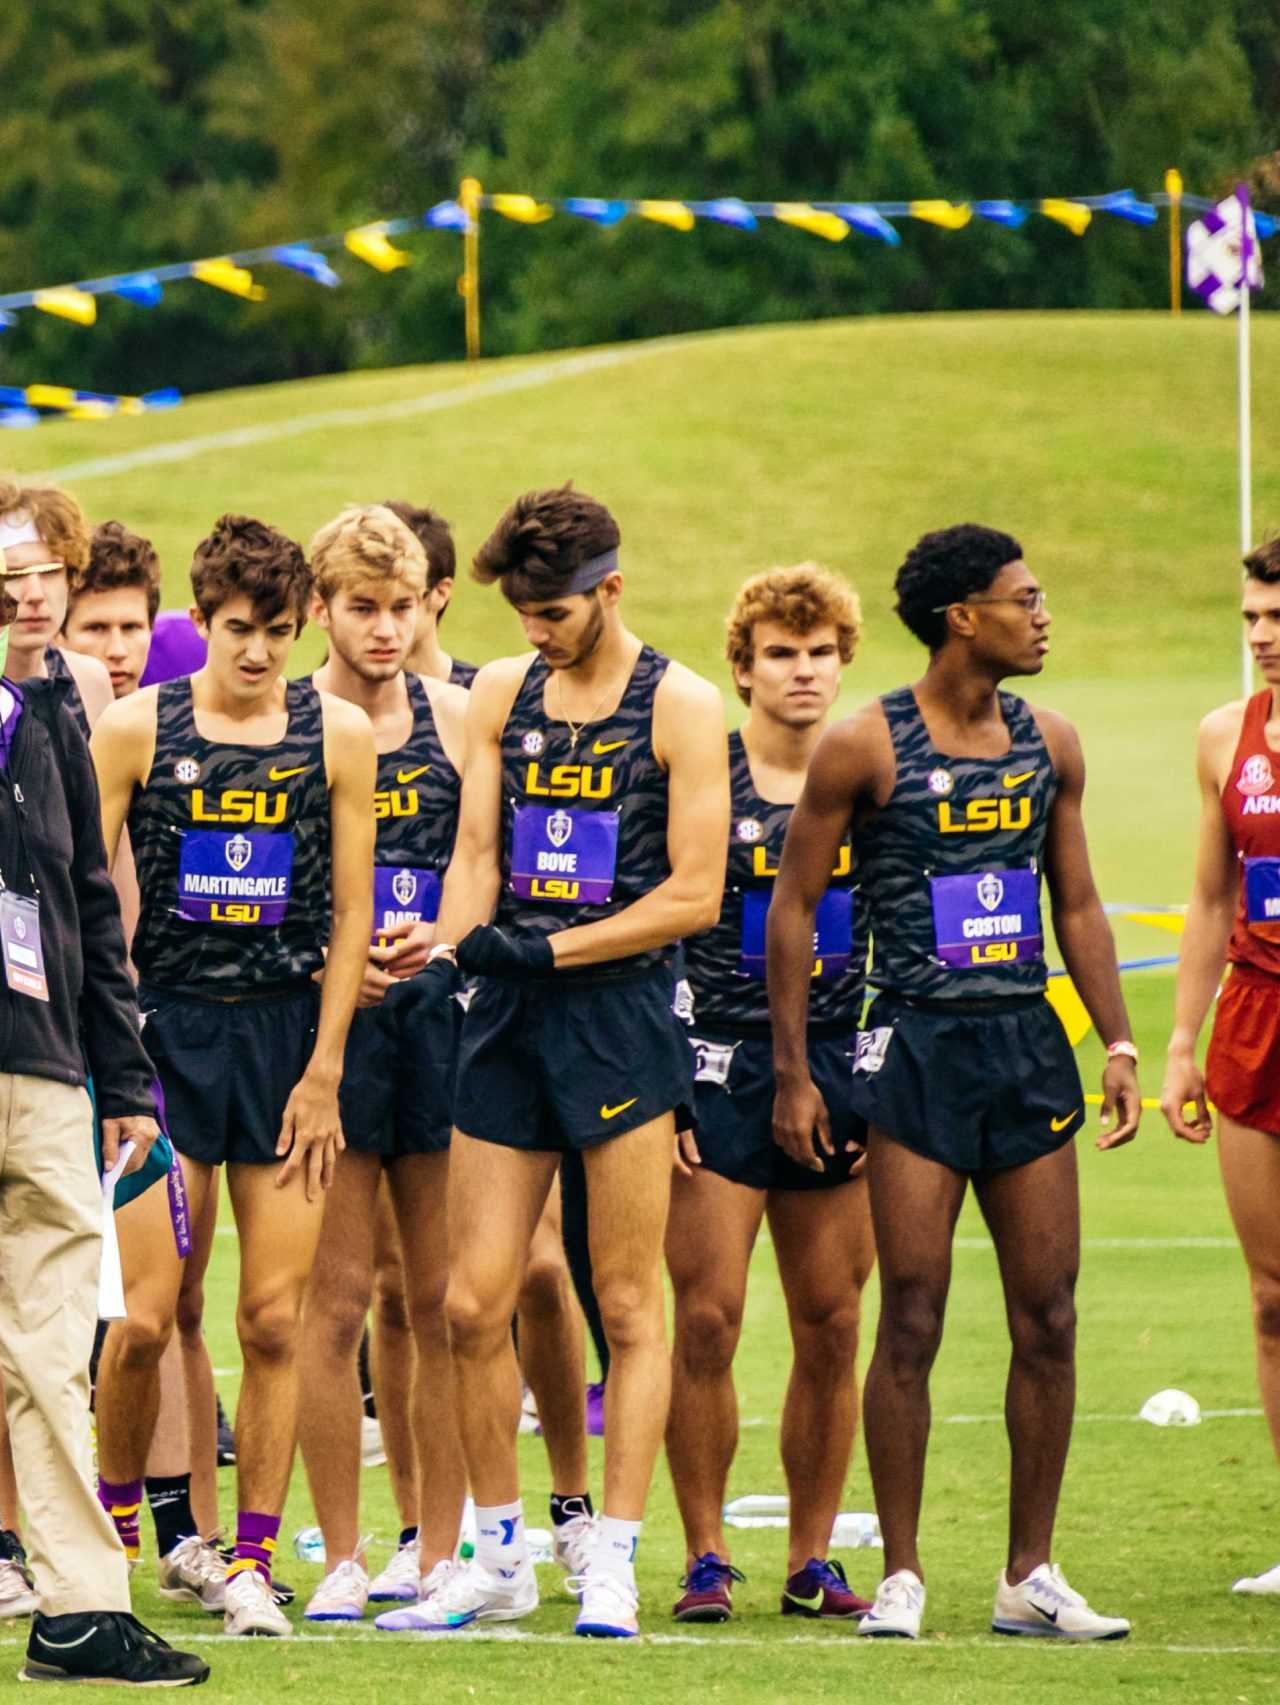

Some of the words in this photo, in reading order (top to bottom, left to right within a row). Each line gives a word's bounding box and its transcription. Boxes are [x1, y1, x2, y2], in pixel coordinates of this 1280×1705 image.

[526, 762, 614, 799] LSU
[191, 789, 288, 824] LSU
[373, 788, 419, 819] SU
[938, 797, 1031, 833] LSU
[536, 851, 577, 873] BOVE
[184, 873, 286, 896] MARTINGAYLE
[531, 879, 580, 900] LSU
[210, 903, 261, 923] LSU
[962, 914, 1022, 938] COSTON
[971, 942, 1017, 964] LSU
